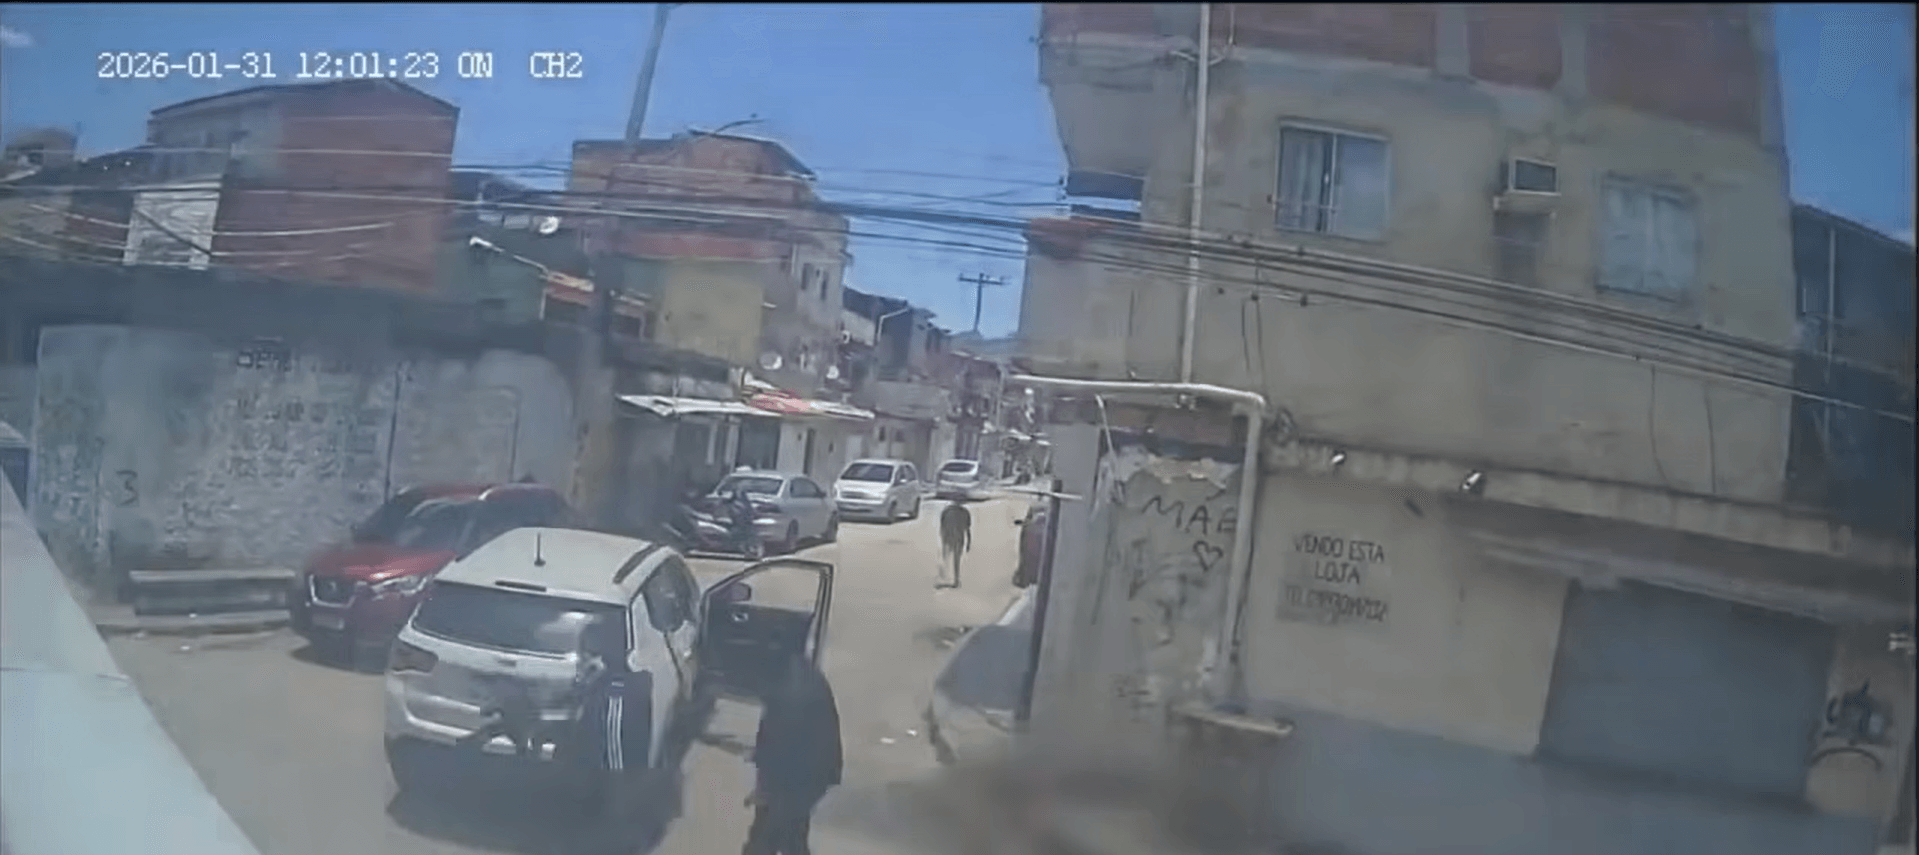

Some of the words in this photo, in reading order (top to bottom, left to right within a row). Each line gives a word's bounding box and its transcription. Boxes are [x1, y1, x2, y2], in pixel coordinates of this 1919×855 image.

[1293, 533, 1344, 558] VENDO
[1349, 540, 1385, 563] ESTA
[1315, 560, 1361, 584] LOJA
